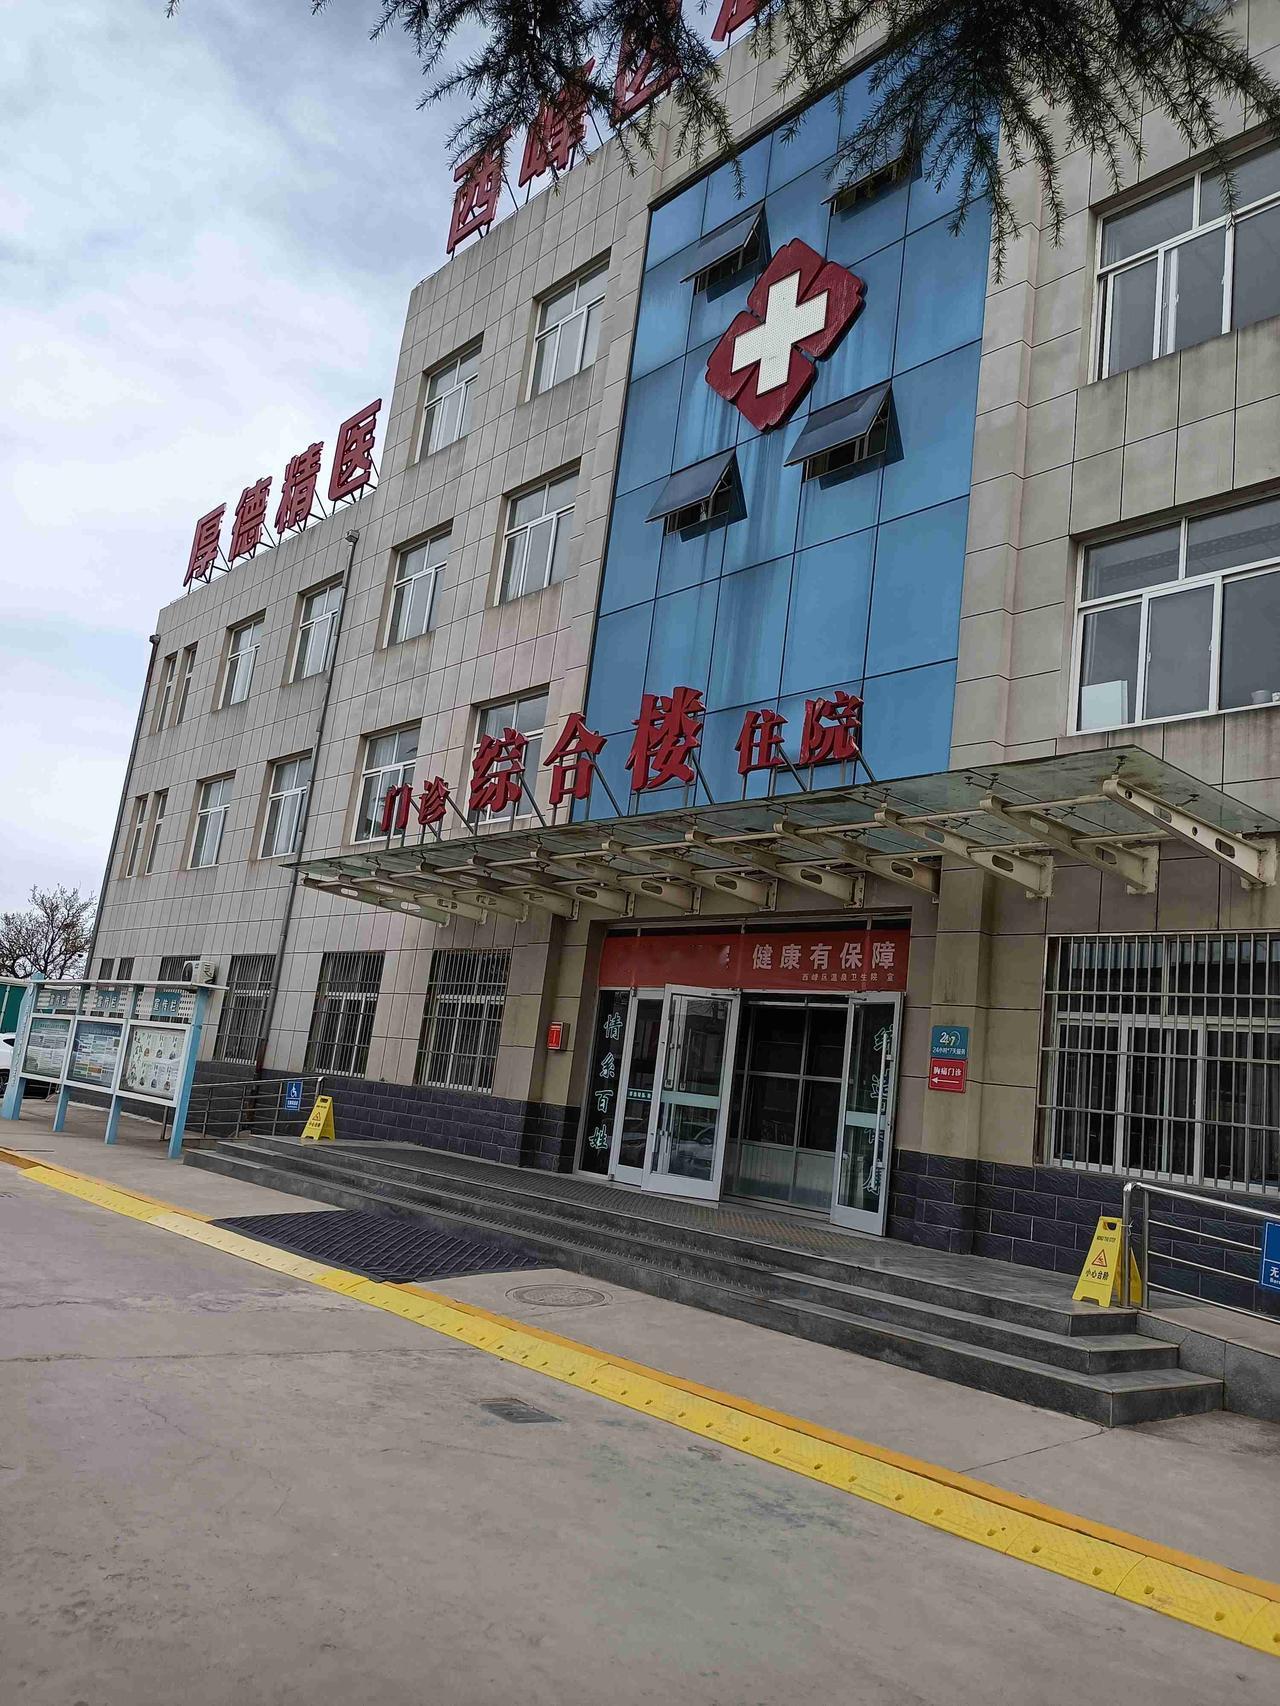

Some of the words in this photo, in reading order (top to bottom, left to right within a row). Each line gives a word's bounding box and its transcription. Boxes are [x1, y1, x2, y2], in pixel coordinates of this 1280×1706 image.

[183, 398, 382, 587] 厚德精医
[380, 774, 451, 832] 门诊
[467, 686, 707, 813] 综合楼
[735, 690, 865, 776] 住院
[752, 941, 895, 970] 健康有保障
[588, 1012, 623, 1150] 情系百姓
